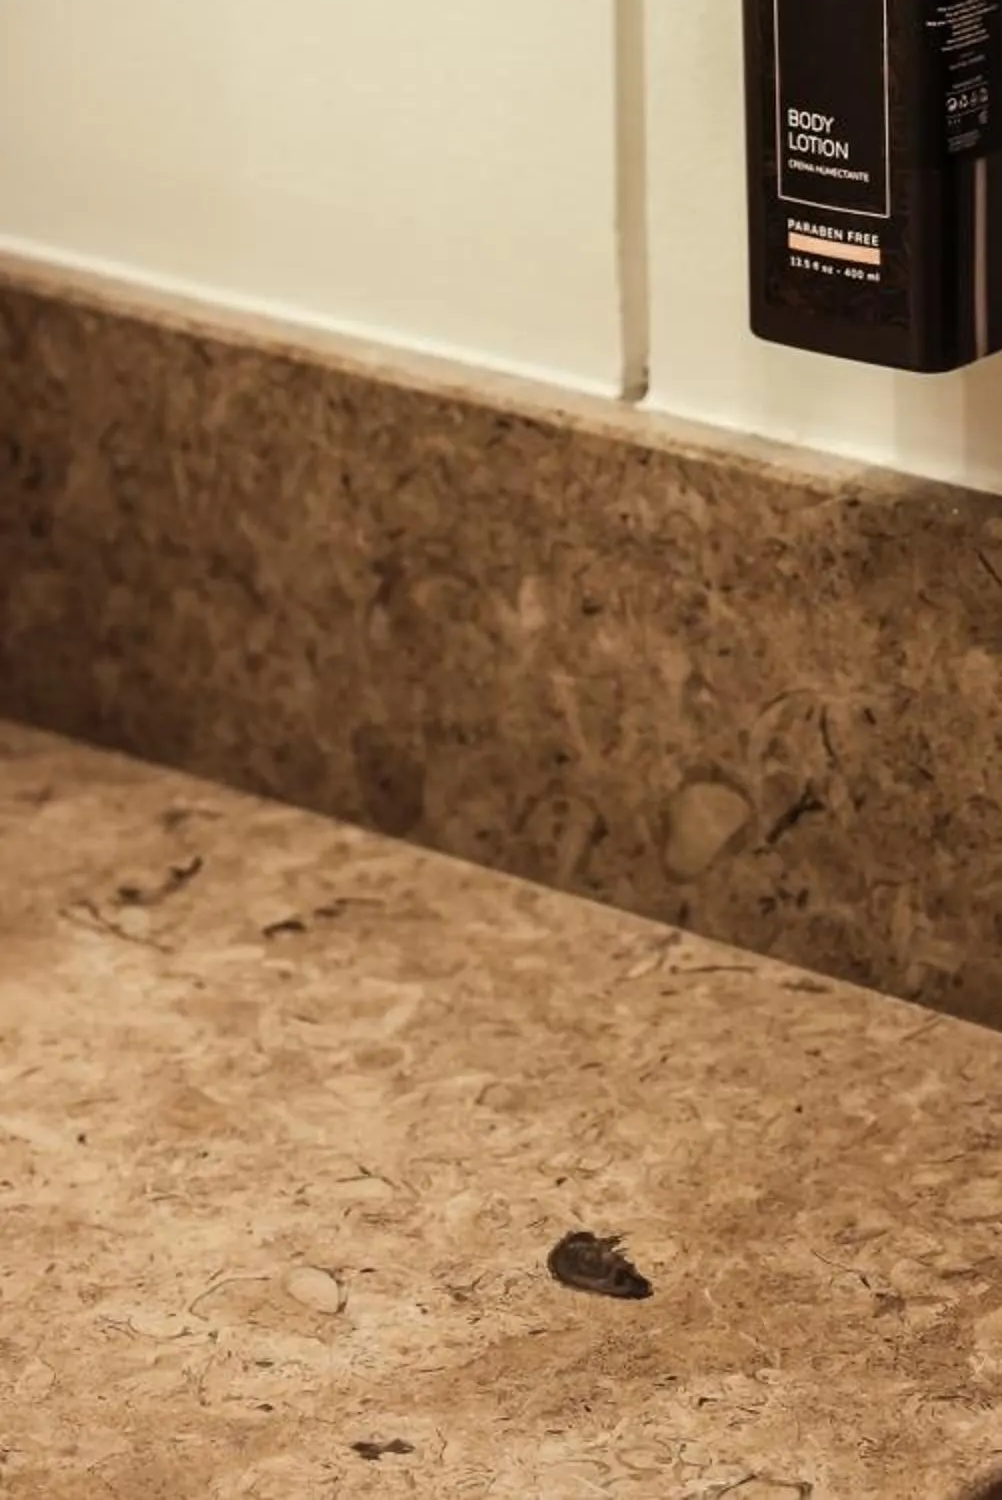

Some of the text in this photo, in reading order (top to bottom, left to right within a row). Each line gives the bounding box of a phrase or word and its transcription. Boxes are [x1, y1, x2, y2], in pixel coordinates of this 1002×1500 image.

[788, 108, 834, 134] BODY
[788, 132, 849, 160] LOTION
[787, 217, 879, 247] PARABEN FREE
